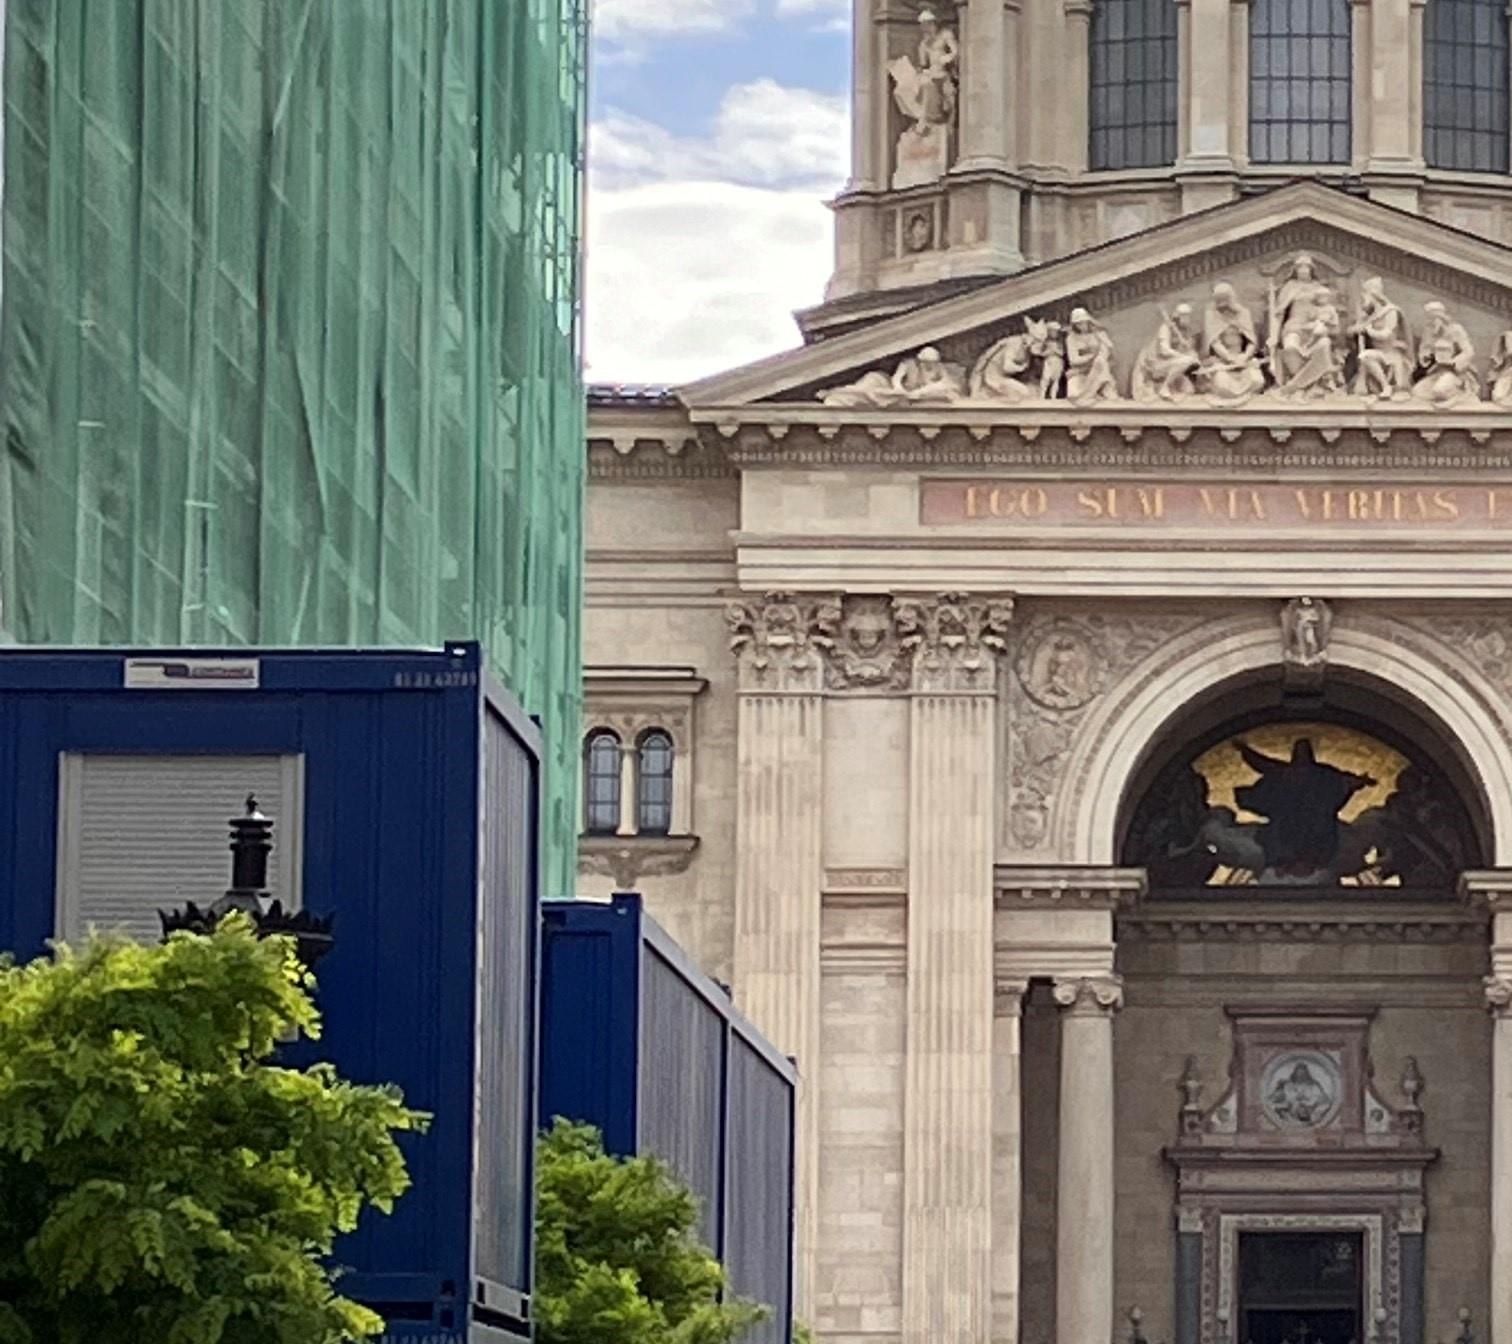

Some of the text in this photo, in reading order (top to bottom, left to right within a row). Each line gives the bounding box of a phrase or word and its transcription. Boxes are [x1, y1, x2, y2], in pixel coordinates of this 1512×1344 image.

[964, 485, 1048, 519] EGO
[1077, 486, 1165, 520] SUM
[1199, 487, 1269, 521] VIA
[1292, 488, 1459, 522] VERITAS
